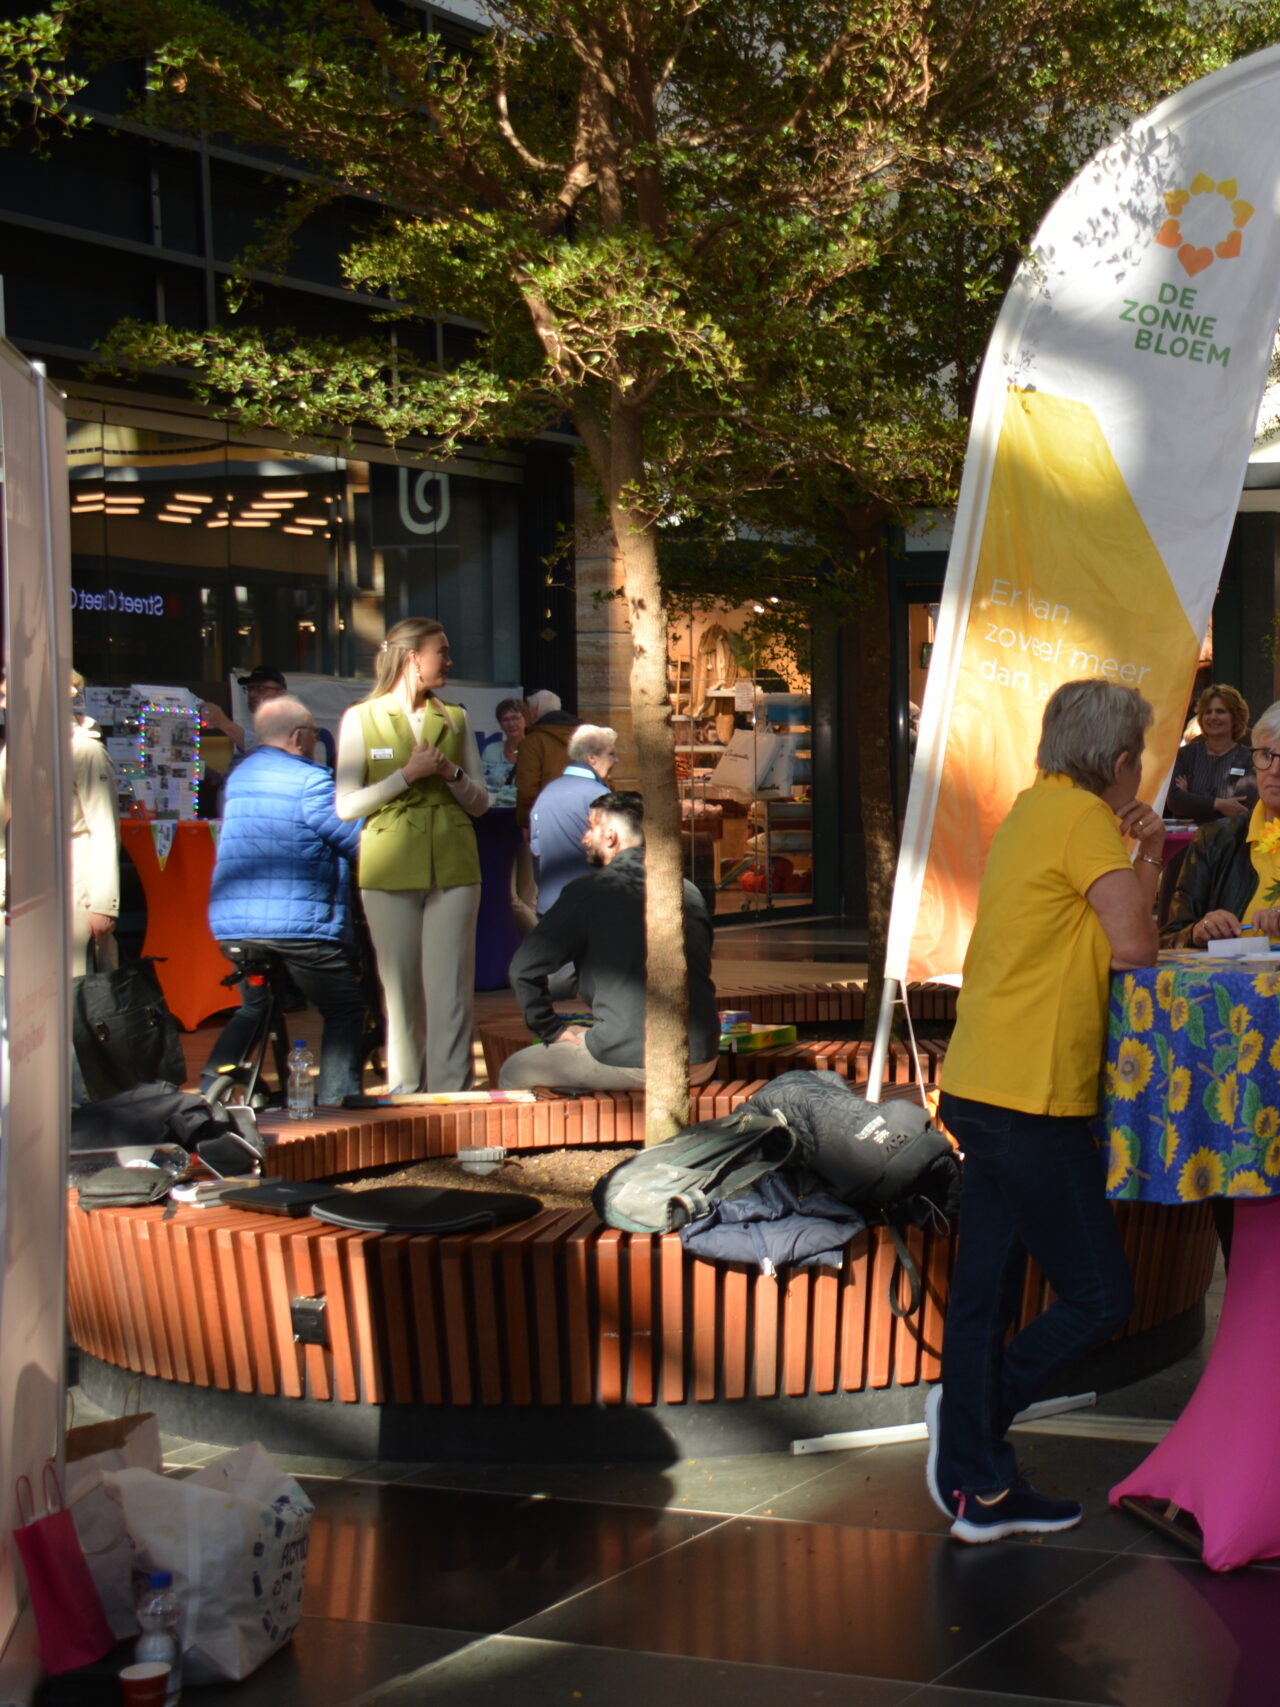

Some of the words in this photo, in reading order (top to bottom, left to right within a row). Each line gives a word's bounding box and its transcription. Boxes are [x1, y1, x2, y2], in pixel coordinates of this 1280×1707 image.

[1158, 282, 1198, 310] DE
[1119, 299, 1217, 339] ZONNE
[1134, 328, 1231, 368] BLOEM
[991, 578, 1023, 608] Er
[1028, 588, 1071, 625] kan
[984, 622, 1062, 664] zoveel
[1070, 650, 1151, 684] meer
[979, 657, 1030, 691] dan
